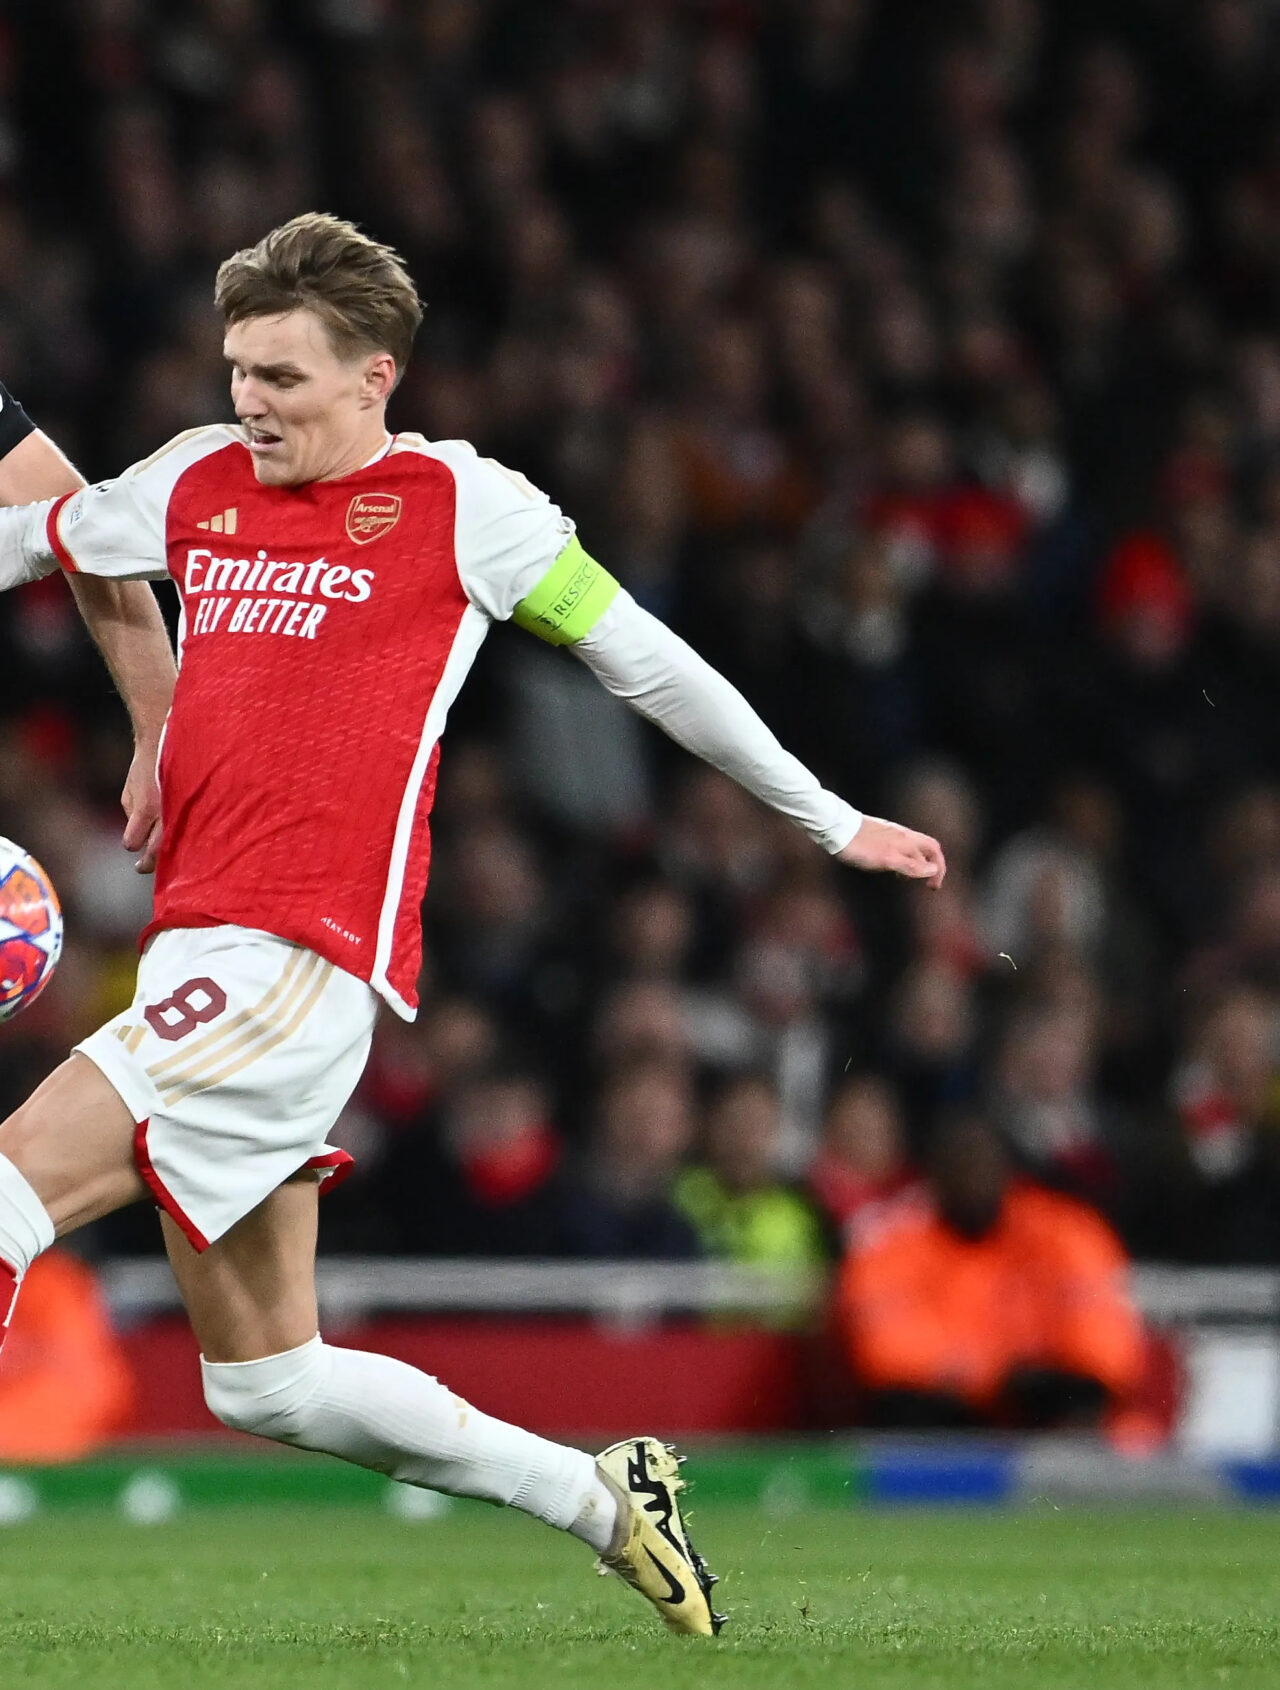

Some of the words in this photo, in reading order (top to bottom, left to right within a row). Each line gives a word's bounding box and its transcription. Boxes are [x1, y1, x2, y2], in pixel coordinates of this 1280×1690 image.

[354, 503, 395, 513] Arsenal
[185, 549, 375, 603] Emirates
[193, 597, 232, 635] FLY
[227, 598, 328, 640] BETTER
[144, 977, 227, 1041] 8
